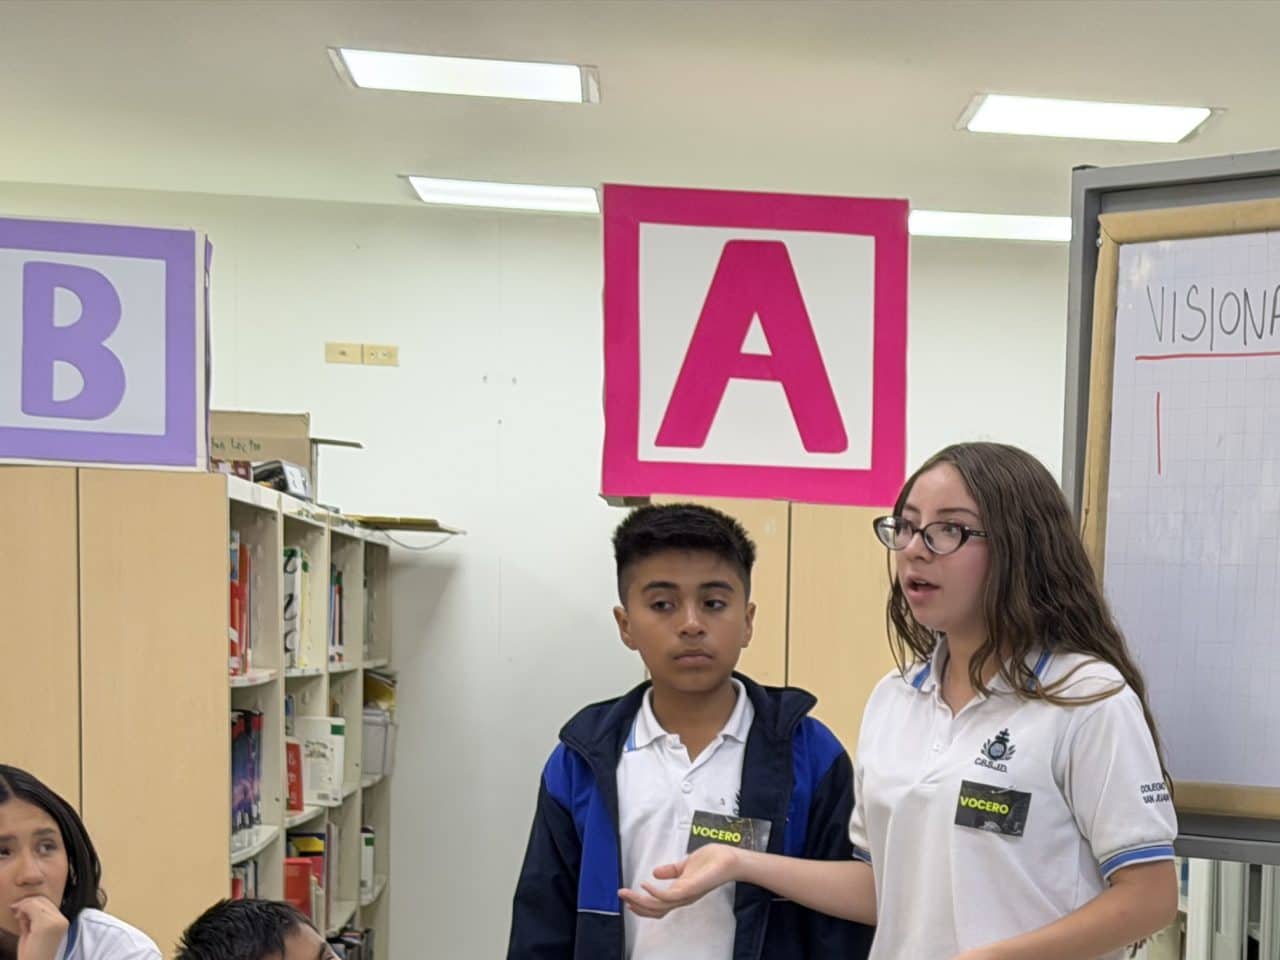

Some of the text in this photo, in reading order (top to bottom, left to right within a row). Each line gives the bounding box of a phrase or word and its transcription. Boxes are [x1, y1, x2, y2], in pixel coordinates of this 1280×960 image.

[21, 261, 126, 420] B
[654, 239, 848, 453] A
[692, 824, 741, 843] VOCERO
[960, 796, 1009, 814] VOCERO
